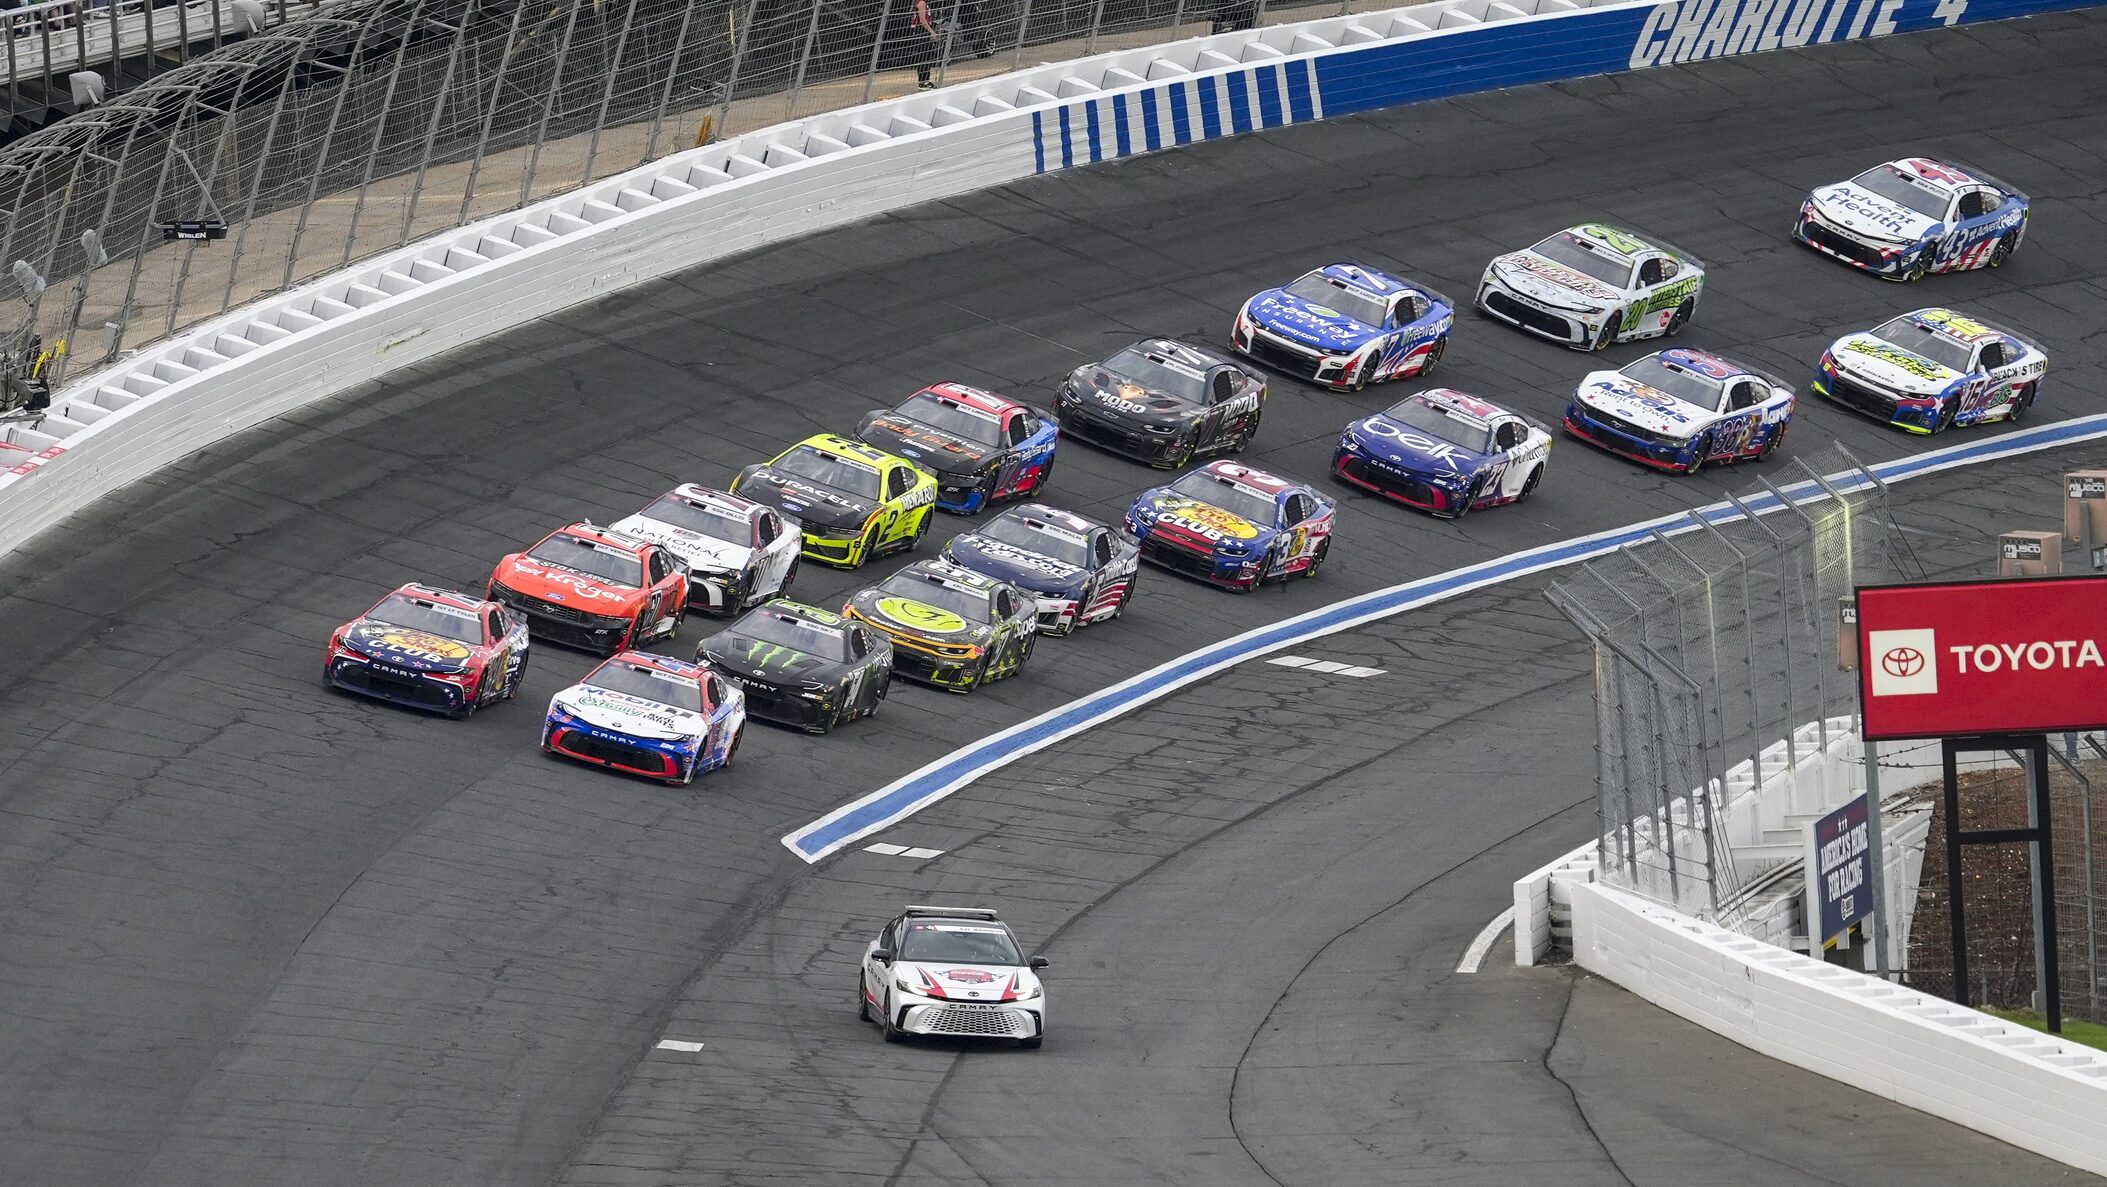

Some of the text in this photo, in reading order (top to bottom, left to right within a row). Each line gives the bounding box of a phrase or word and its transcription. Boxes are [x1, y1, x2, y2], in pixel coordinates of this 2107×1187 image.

[1826, 194, 1903, 235] Health
[1832, 187, 1916, 224] Advent
[1825, 224, 1861, 241] CAMRY
[1943, 229, 1969, 260] 43
[1511, 293, 1547, 310] CAMRY
[1620, 297, 1648, 333] 20
[1254, 306, 1351, 346] INSURANCE
[1261, 298, 1360, 339] Freeway
[1268, 319, 1320, 342] Freeway.com
[2028, 361, 2043, 375] TIRE
[1094, 389, 1147, 414] MODO
[1600, 389, 1628, 404] Rent
[1630, 400, 1640, 408] to
[1363, 417, 1471, 470] belk
[1371, 459, 1411, 477] CAMRY
[752, 471, 866, 512] DURACELL
[877, 509, 898, 544] 2
[1157, 513, 1225, 541] CLUB
[630, 522, 721, 561] NATIONAL
[1276, 532, 1292, 566] 3
[2004, 543, 2041, 553] musco
[545, 573, 626, 602] Kroger
[368, 639, 443, 663] CLUB
[1950, 640, 2105, 673] TOYOTA
[372, 663, 418, 678] CAMRY
[733, 676, 777, 691] CAMRY
[579, 686, 660, 709] Mobil
[591, 730, 637, 745] CAMRY
[1821, 821, 1868, 875] AMERICA'S HOME
[1828, 857, 1863, 902] FOR RACING
